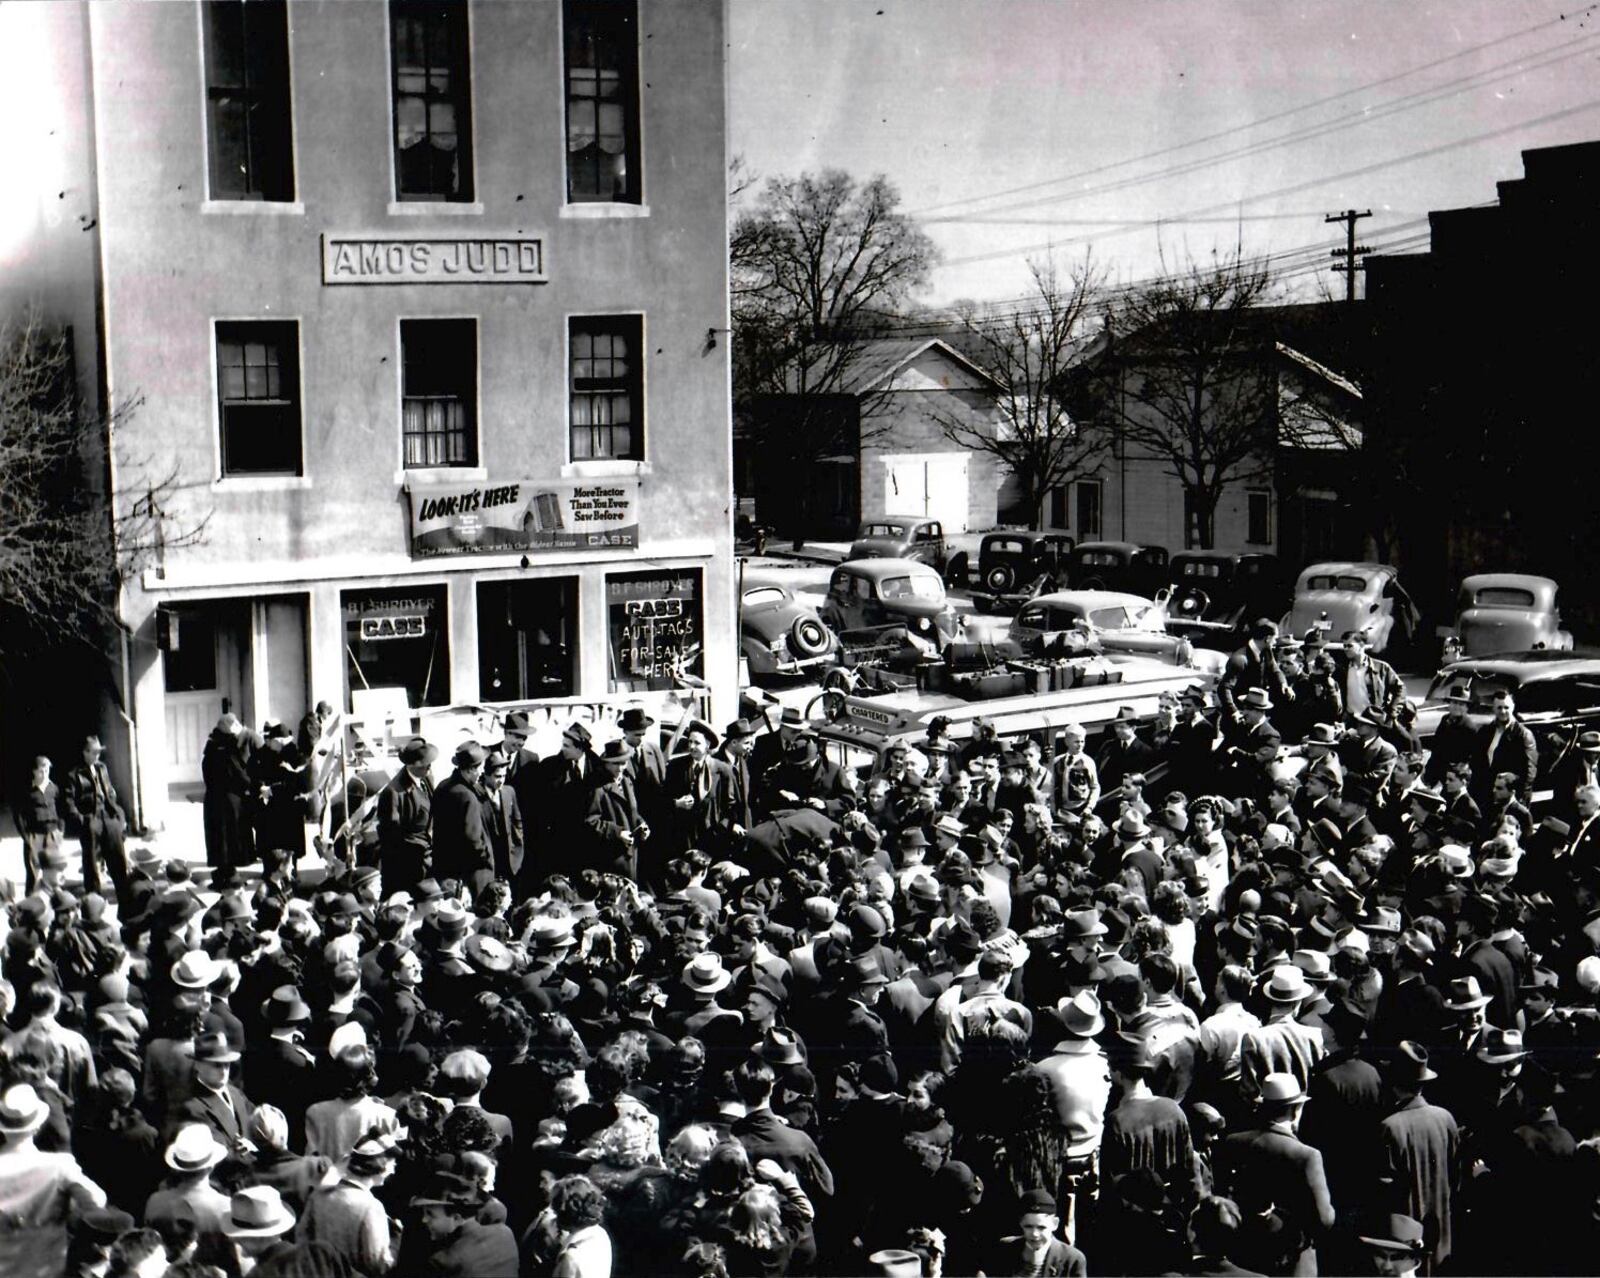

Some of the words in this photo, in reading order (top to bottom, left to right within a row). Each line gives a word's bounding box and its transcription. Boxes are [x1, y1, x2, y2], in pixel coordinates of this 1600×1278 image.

[333, 242, 431, 275] AMOS
[443, 242, 537, 275] JUDD
[482, 484, 520, 508] HERE
[574, 487, 595, 498] More
[594, 486, 625, 497] Tractor
[570, 499, 592, 510] Than
[592, 498, 607, 509] You
[608, 498, 629, 508] Ever
[574, 510, 592, 522] Saw
[593, 509, 625, 521] Before
[588, 535, 632, 546] CASE
[625, 599, 683, 619] CASE
[361, 615, 425, 640] CASE
[851, 706, 889, 724] CHARTERED
